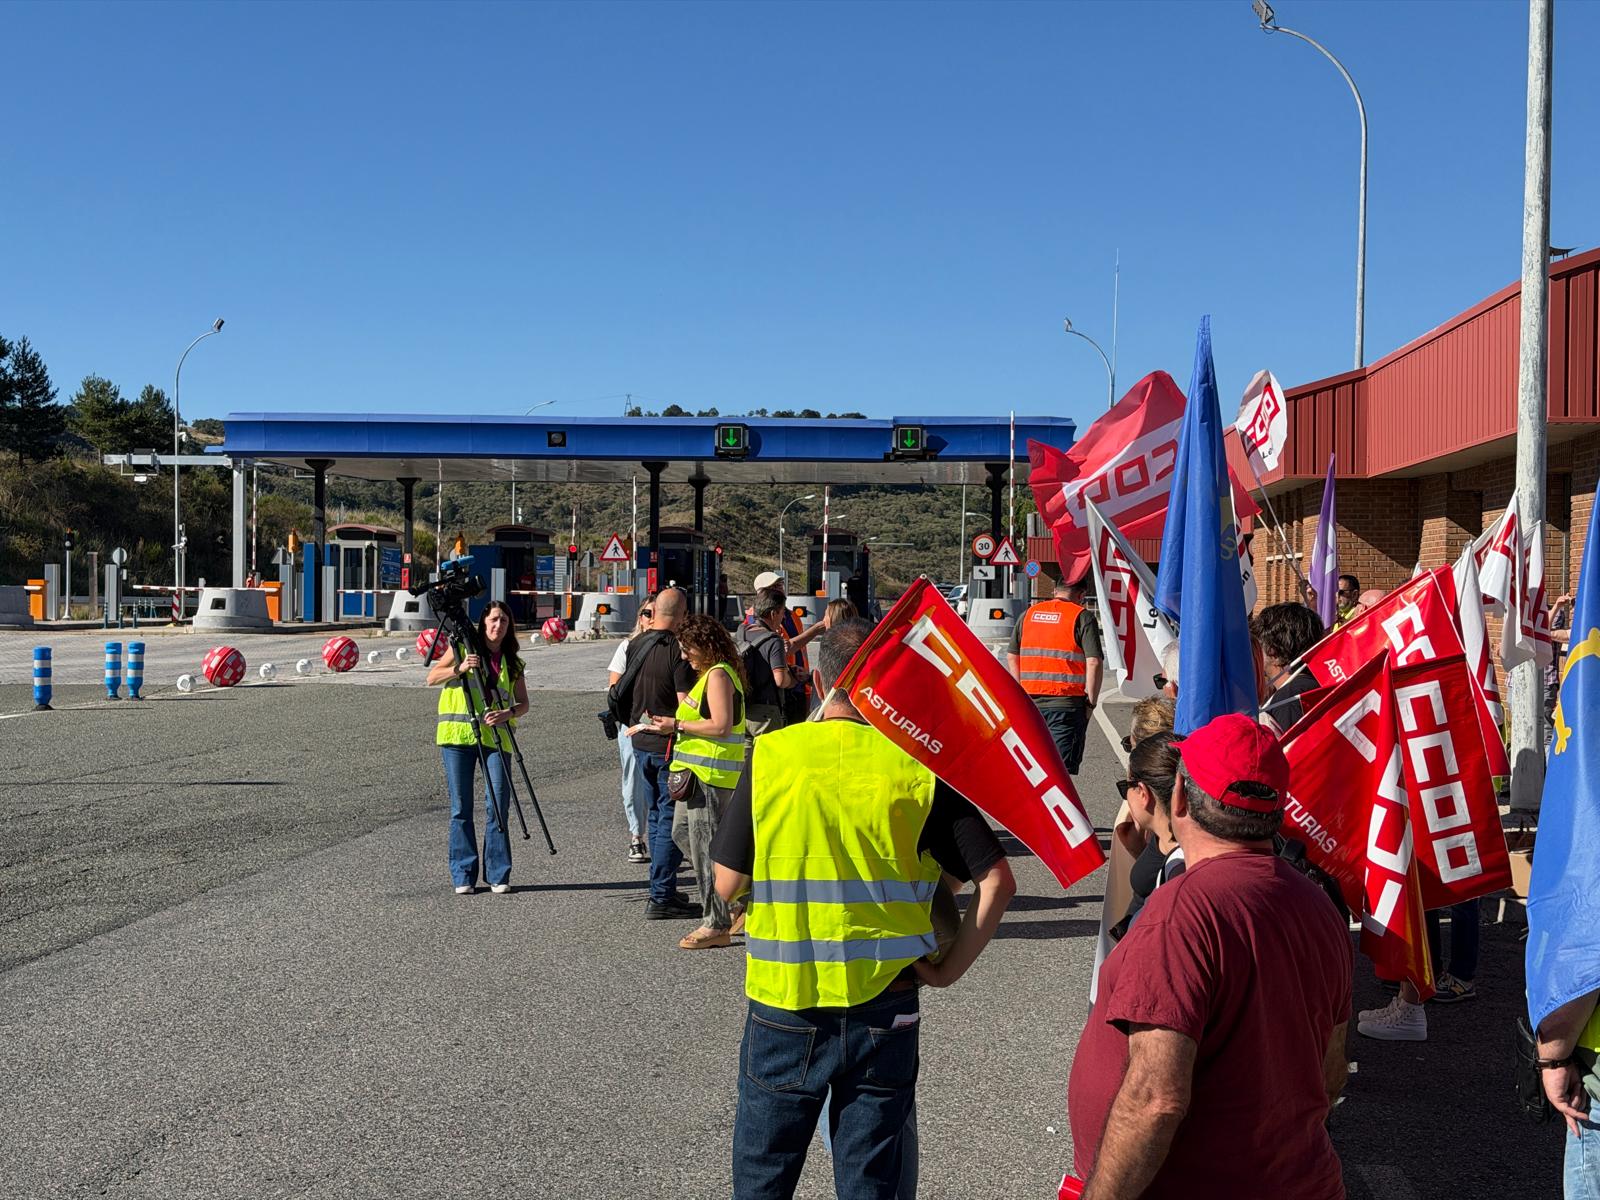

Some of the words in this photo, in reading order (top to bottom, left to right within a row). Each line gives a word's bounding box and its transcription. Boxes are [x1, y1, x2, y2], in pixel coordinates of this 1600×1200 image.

[978, 542, 990, 551] 30
[1033, 612, 1059, 622] CCOO
[859, 685, 944, 755] ASTURIAS
[901, 615, 1095, 849] CCOO
[1394, 679, 1484, 885] CCOO
[1283, 791, 1338, 854] TURIAS
